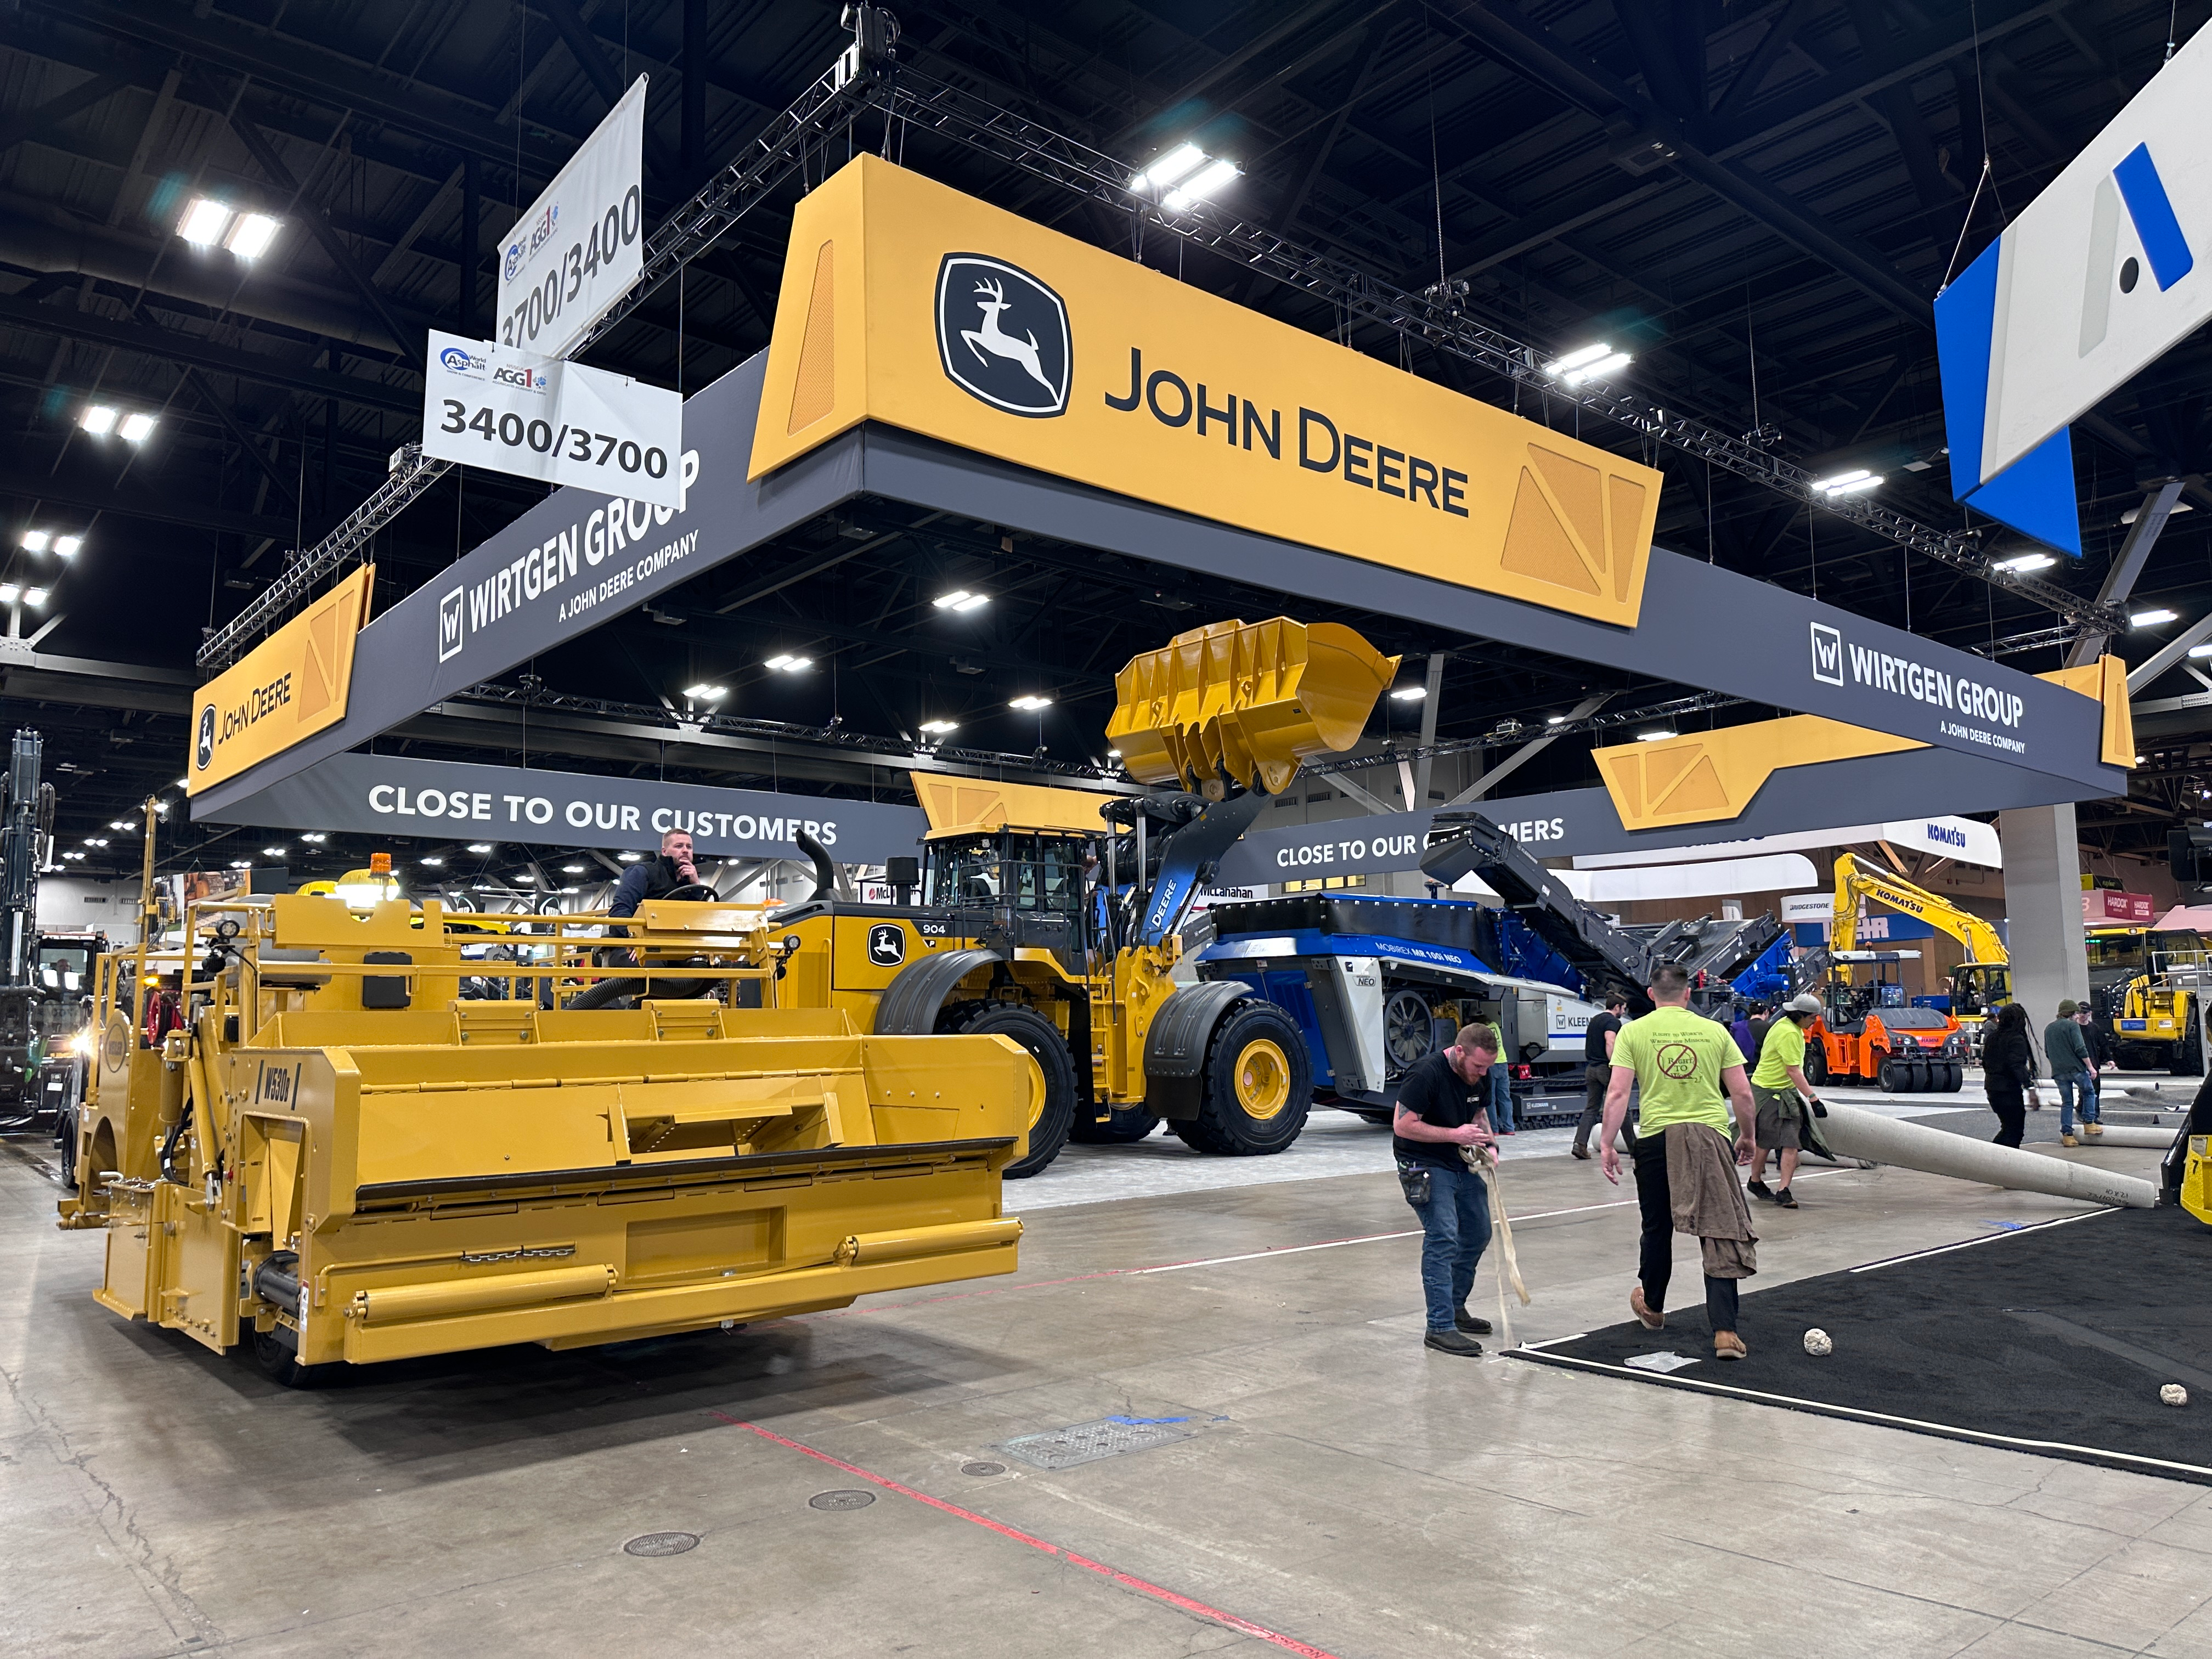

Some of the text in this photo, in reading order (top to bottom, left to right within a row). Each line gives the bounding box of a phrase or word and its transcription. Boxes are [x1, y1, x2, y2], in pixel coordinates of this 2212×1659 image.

[529, 205, 551, 256] AGG1
[447, 355, 486, 371] Asphalt
[469, 354, 487, 363] World
[493, 368, 532, 388] AGG1
[441, 399, 667, 478] 3400/3700
[1105, 347, 1469, 518] JOHN DEERE
[470, 524, 577, 633] WIRTGEN
[559, 529, 699, 622] A JOHN DEERE COMPANY
[1849, 643, 1953, 709] WIRTGEN
[1956, 679, 2023, 727] GROUP
[218, 672, 291, 745] JOHN DEERE
[1940, 720, 2025, 754] A JOHN DEERE COMPANY
[369, 785, 837, 845] CLOSE TO OUR CUSTOMERS
[1277, 841, 1334, 867] CLOSE
[1339, 840, 1366, 861] TO
[1372, 834, 1416, 857] OUR
[1927, 823, 1965, 848] KOMATSU
[1151, 879, 1177, 928] DEERE
[1875, 889, 1923, 913] KOMATSU
[2108, 896, 2128, 909] HARDOX
[923, 924, 945, 934] 904
[1375, 943, 1462, 964] MOBIREX MR 100i NEO
[2192, 1159, 2199, 1175] 7
